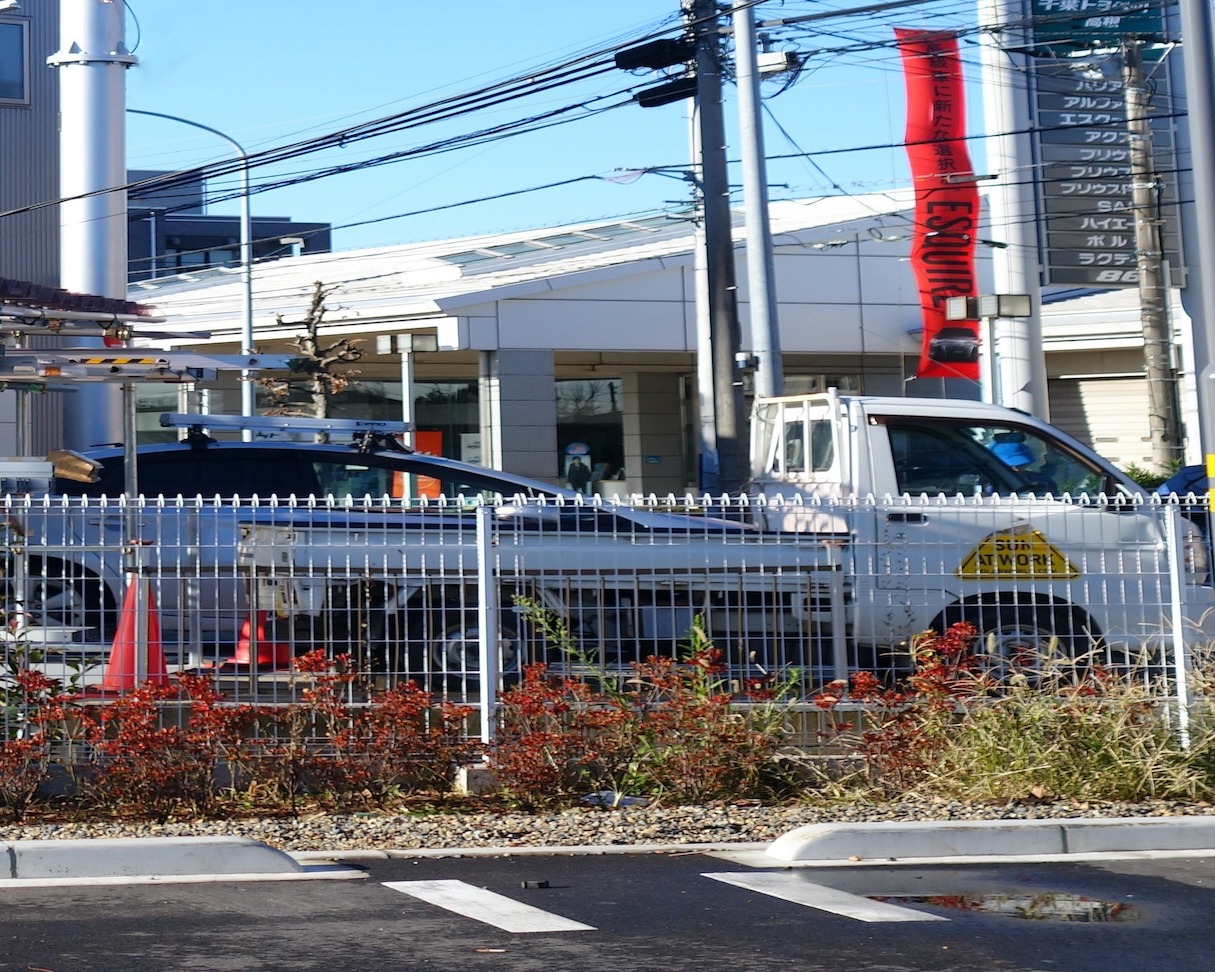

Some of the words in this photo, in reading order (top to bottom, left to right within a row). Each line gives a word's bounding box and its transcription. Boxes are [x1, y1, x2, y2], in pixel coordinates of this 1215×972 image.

[1096, 270, 1140, 282] 86
[995, 539, 1032, 551] SUN
[975, 554, 994, 566] AT
[997, 554, 1056, 566] WORK
